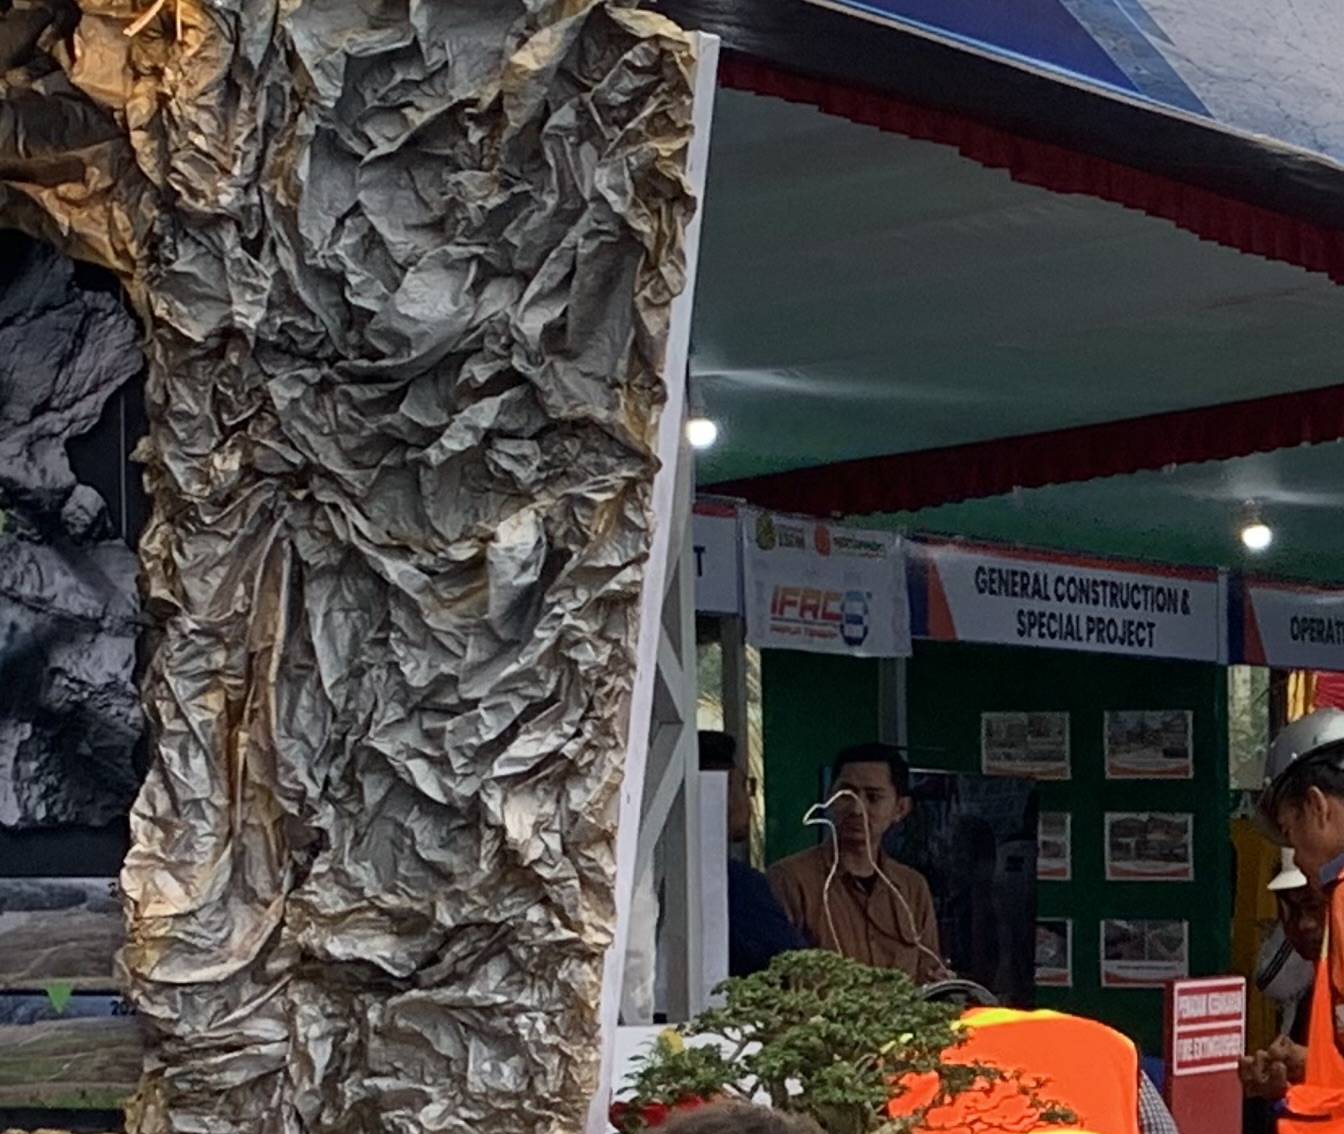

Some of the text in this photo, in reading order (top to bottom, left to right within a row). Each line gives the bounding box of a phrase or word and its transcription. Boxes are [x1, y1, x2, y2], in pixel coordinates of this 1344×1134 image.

[974, 565, 1192, 616] GENERAL CONSTRUCTION &
[1016, 608, 1156, 648] SPECIAL PROJECT
